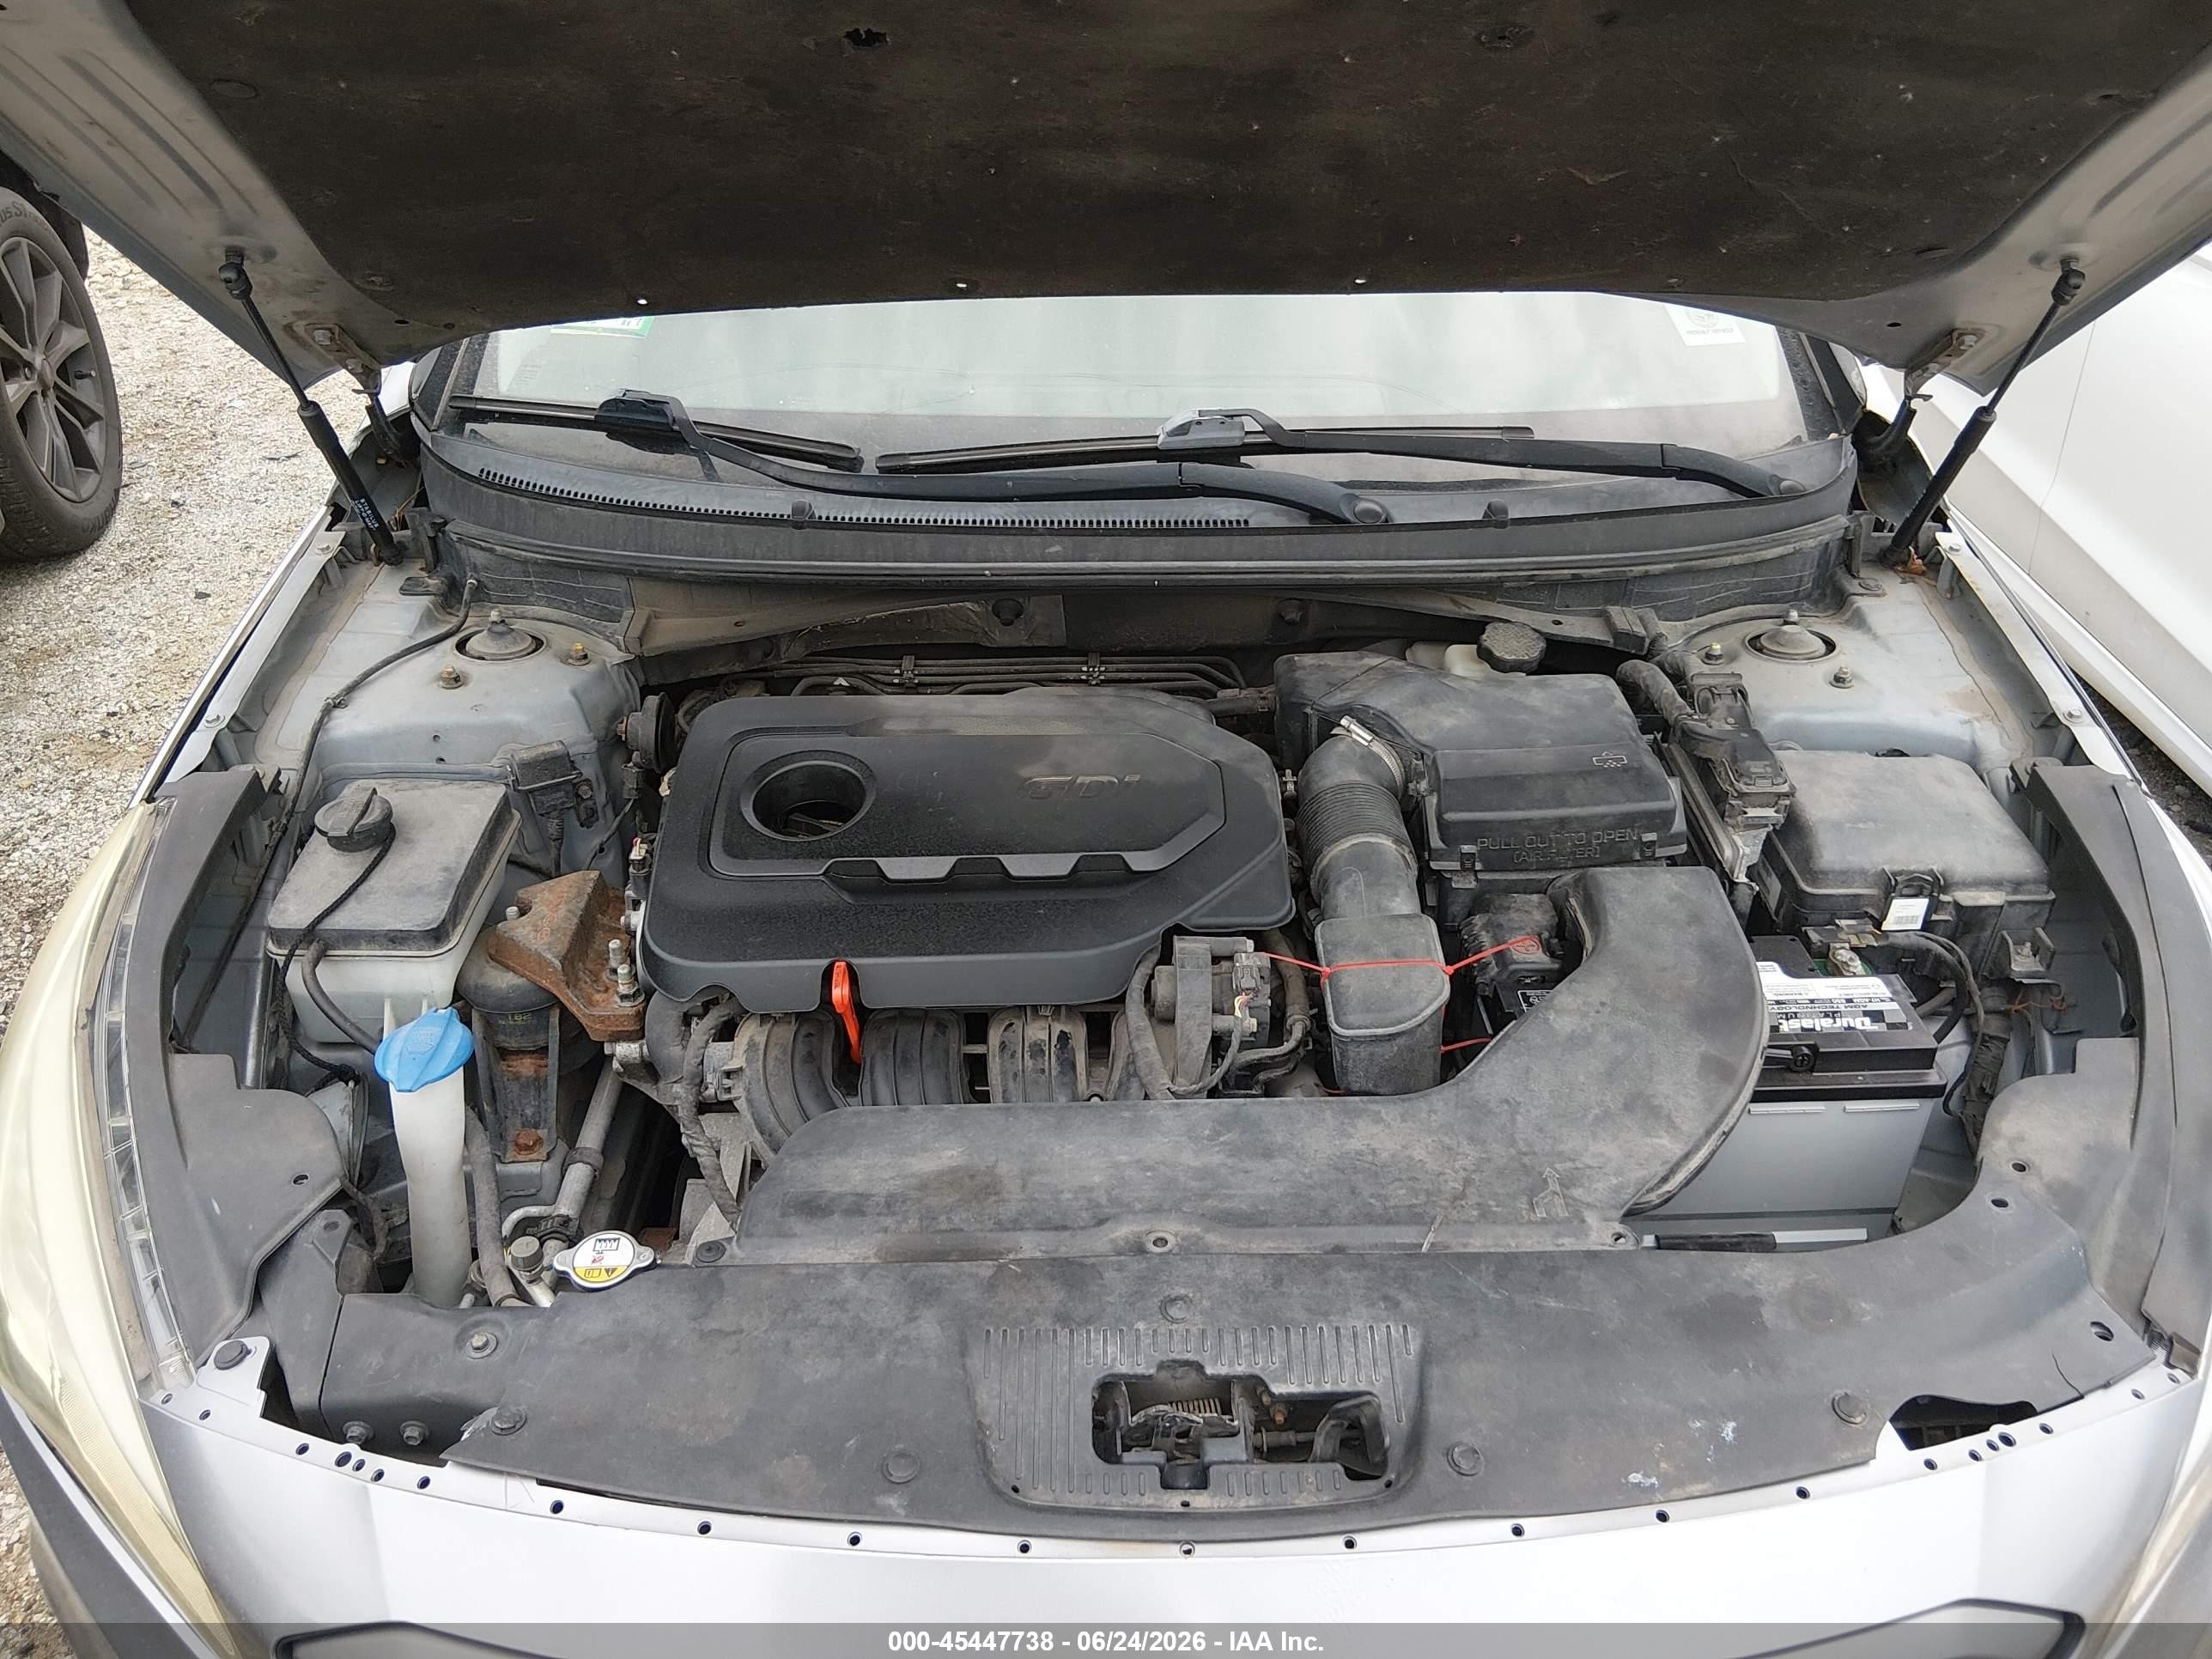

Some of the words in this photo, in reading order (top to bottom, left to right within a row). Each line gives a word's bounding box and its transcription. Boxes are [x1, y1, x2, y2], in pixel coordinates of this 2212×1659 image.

[360, 499, 379, 527] STABILUS
[1477, 837, 1519, 850] PULL
[1525, 835, 1559, 848] OUT
[1564, 832, 1586, 845] TO
[1592, 829, 1638, 843] OPEN
[1778, 1018, 1879, 1031] Duralast
